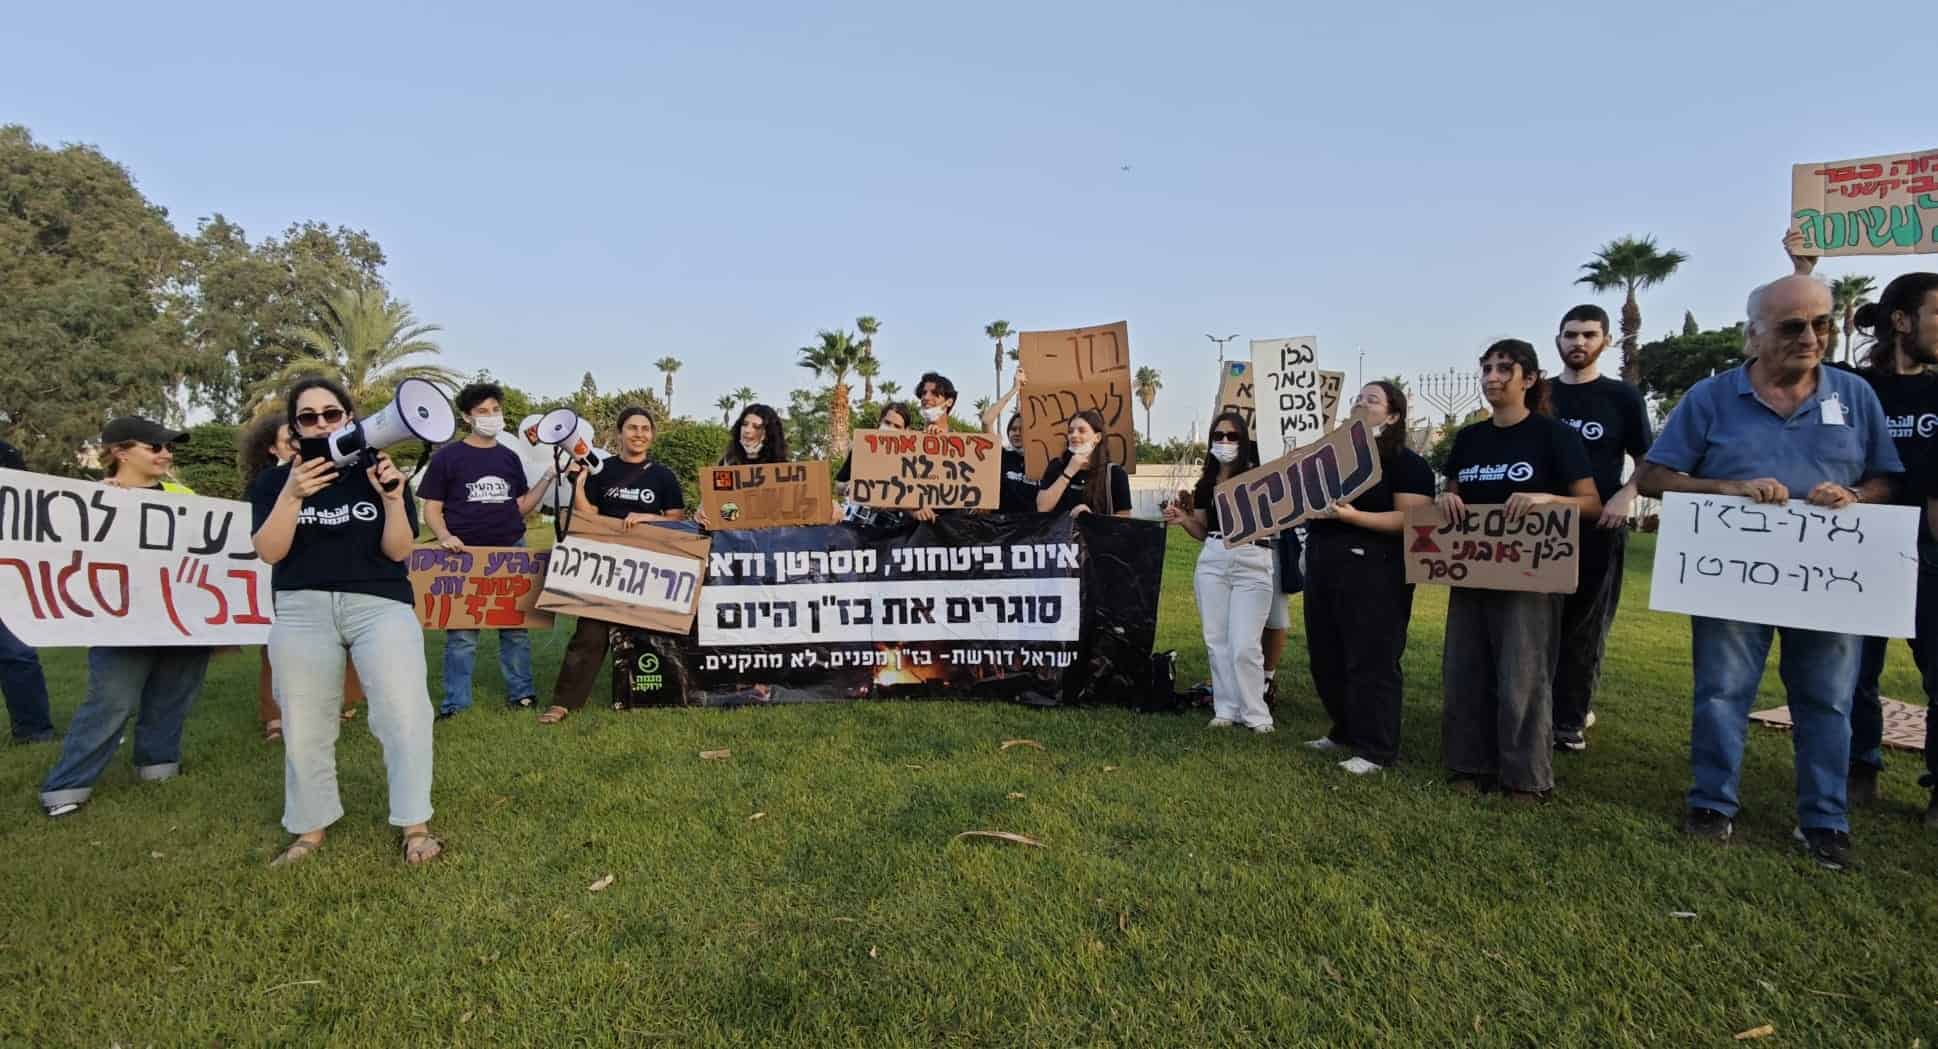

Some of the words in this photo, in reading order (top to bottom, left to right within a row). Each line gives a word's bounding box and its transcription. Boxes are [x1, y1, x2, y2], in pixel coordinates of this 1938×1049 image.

[1814, 163, 1883, 184] כבר
[1267, 370, 1316, 392] נגמר
[1280, 390, 1317, 411] לכם
[1280, 413, 1319, 436] הזמן
[901, 453, 934, 479] לא
[942, 459, 975, 483] זה
[854, 475, 915, 505] ילדים
[1216, 419, 1374, 544] נחנקנו
[916, 482, 982, 508] משחק
[139, 502, 259, 560] עים
[884, 545, 1004, 577] ביטחוני,
[1010, 543, 1080, 570] איום
[1452, 540, 1493, 561] בתי
[706, 551, 767, 578] ודא
[773, 548, 877, 583] מסרטן
[1420, 557, 1468, 581] ספר
[0, 550, 130, 620] סגור
[160, 556, 273, 636] בז"ן
[716, 600, 798, 630] היום
[808, 595, 874, 633] בז"ן
[882, 595, 937, 625] את
[945, 594, 1062, 625] סוגרים
[699, 652, 784, 674] מתקנים.
[790, 649, 817, 668] לא
[824, 650, 889, 669] מפנים,
[896, 647, 933, 670] בז"ן
[1021, 647, 1078, 668] ישראל
